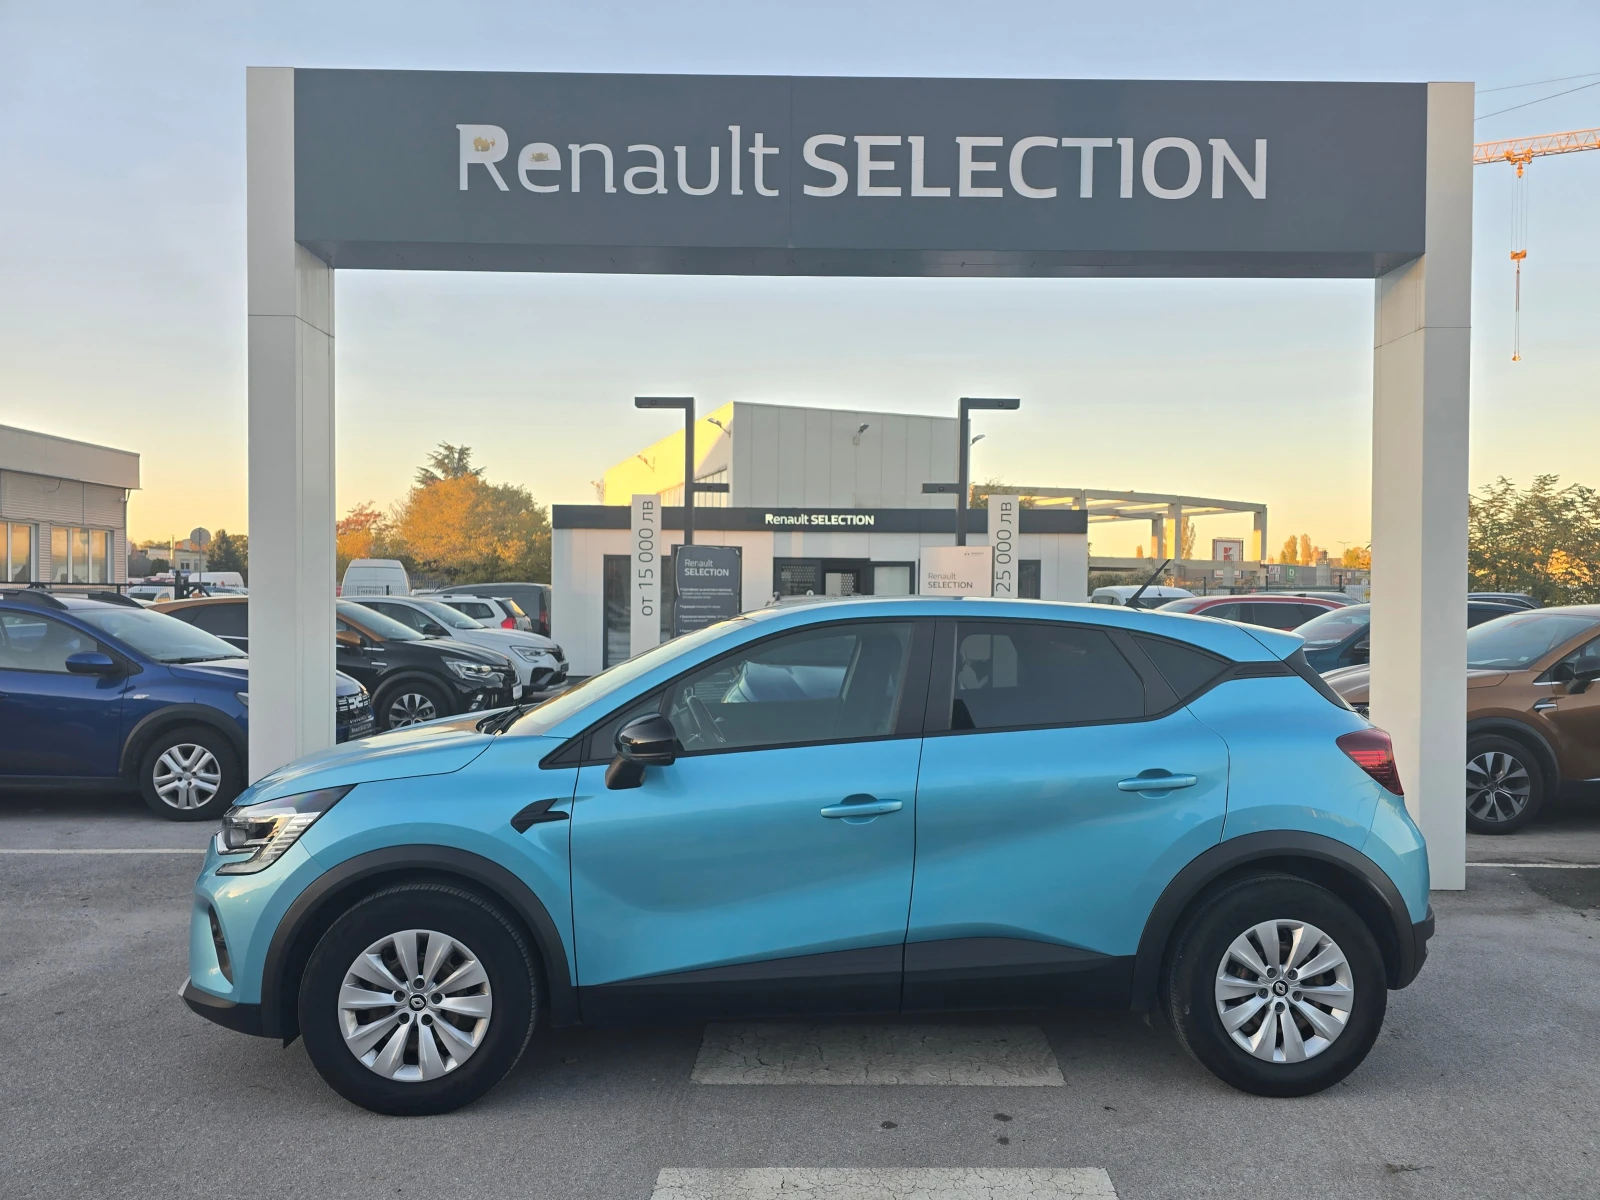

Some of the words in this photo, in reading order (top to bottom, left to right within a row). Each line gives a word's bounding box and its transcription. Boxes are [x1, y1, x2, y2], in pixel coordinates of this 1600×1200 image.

[456, 124, 779, 197] Renault
[803, 134, 1267, 200] SELECTION
[765, 513, 809, 525] Renault
[811, 515, 874, 525] SELECTION
[638, 528, 653, 562] 000
[996, 529, 1012, 564] 000
[684, 559, 713, 568] Renault
[638, 568, 653, 590] 15
[684, 568, 729, 577] SELECTION
[928, 572, 957, 580] Renault
[928, 581, 973, 589] SELECTION
[996, 571, 1012, 593] 25
